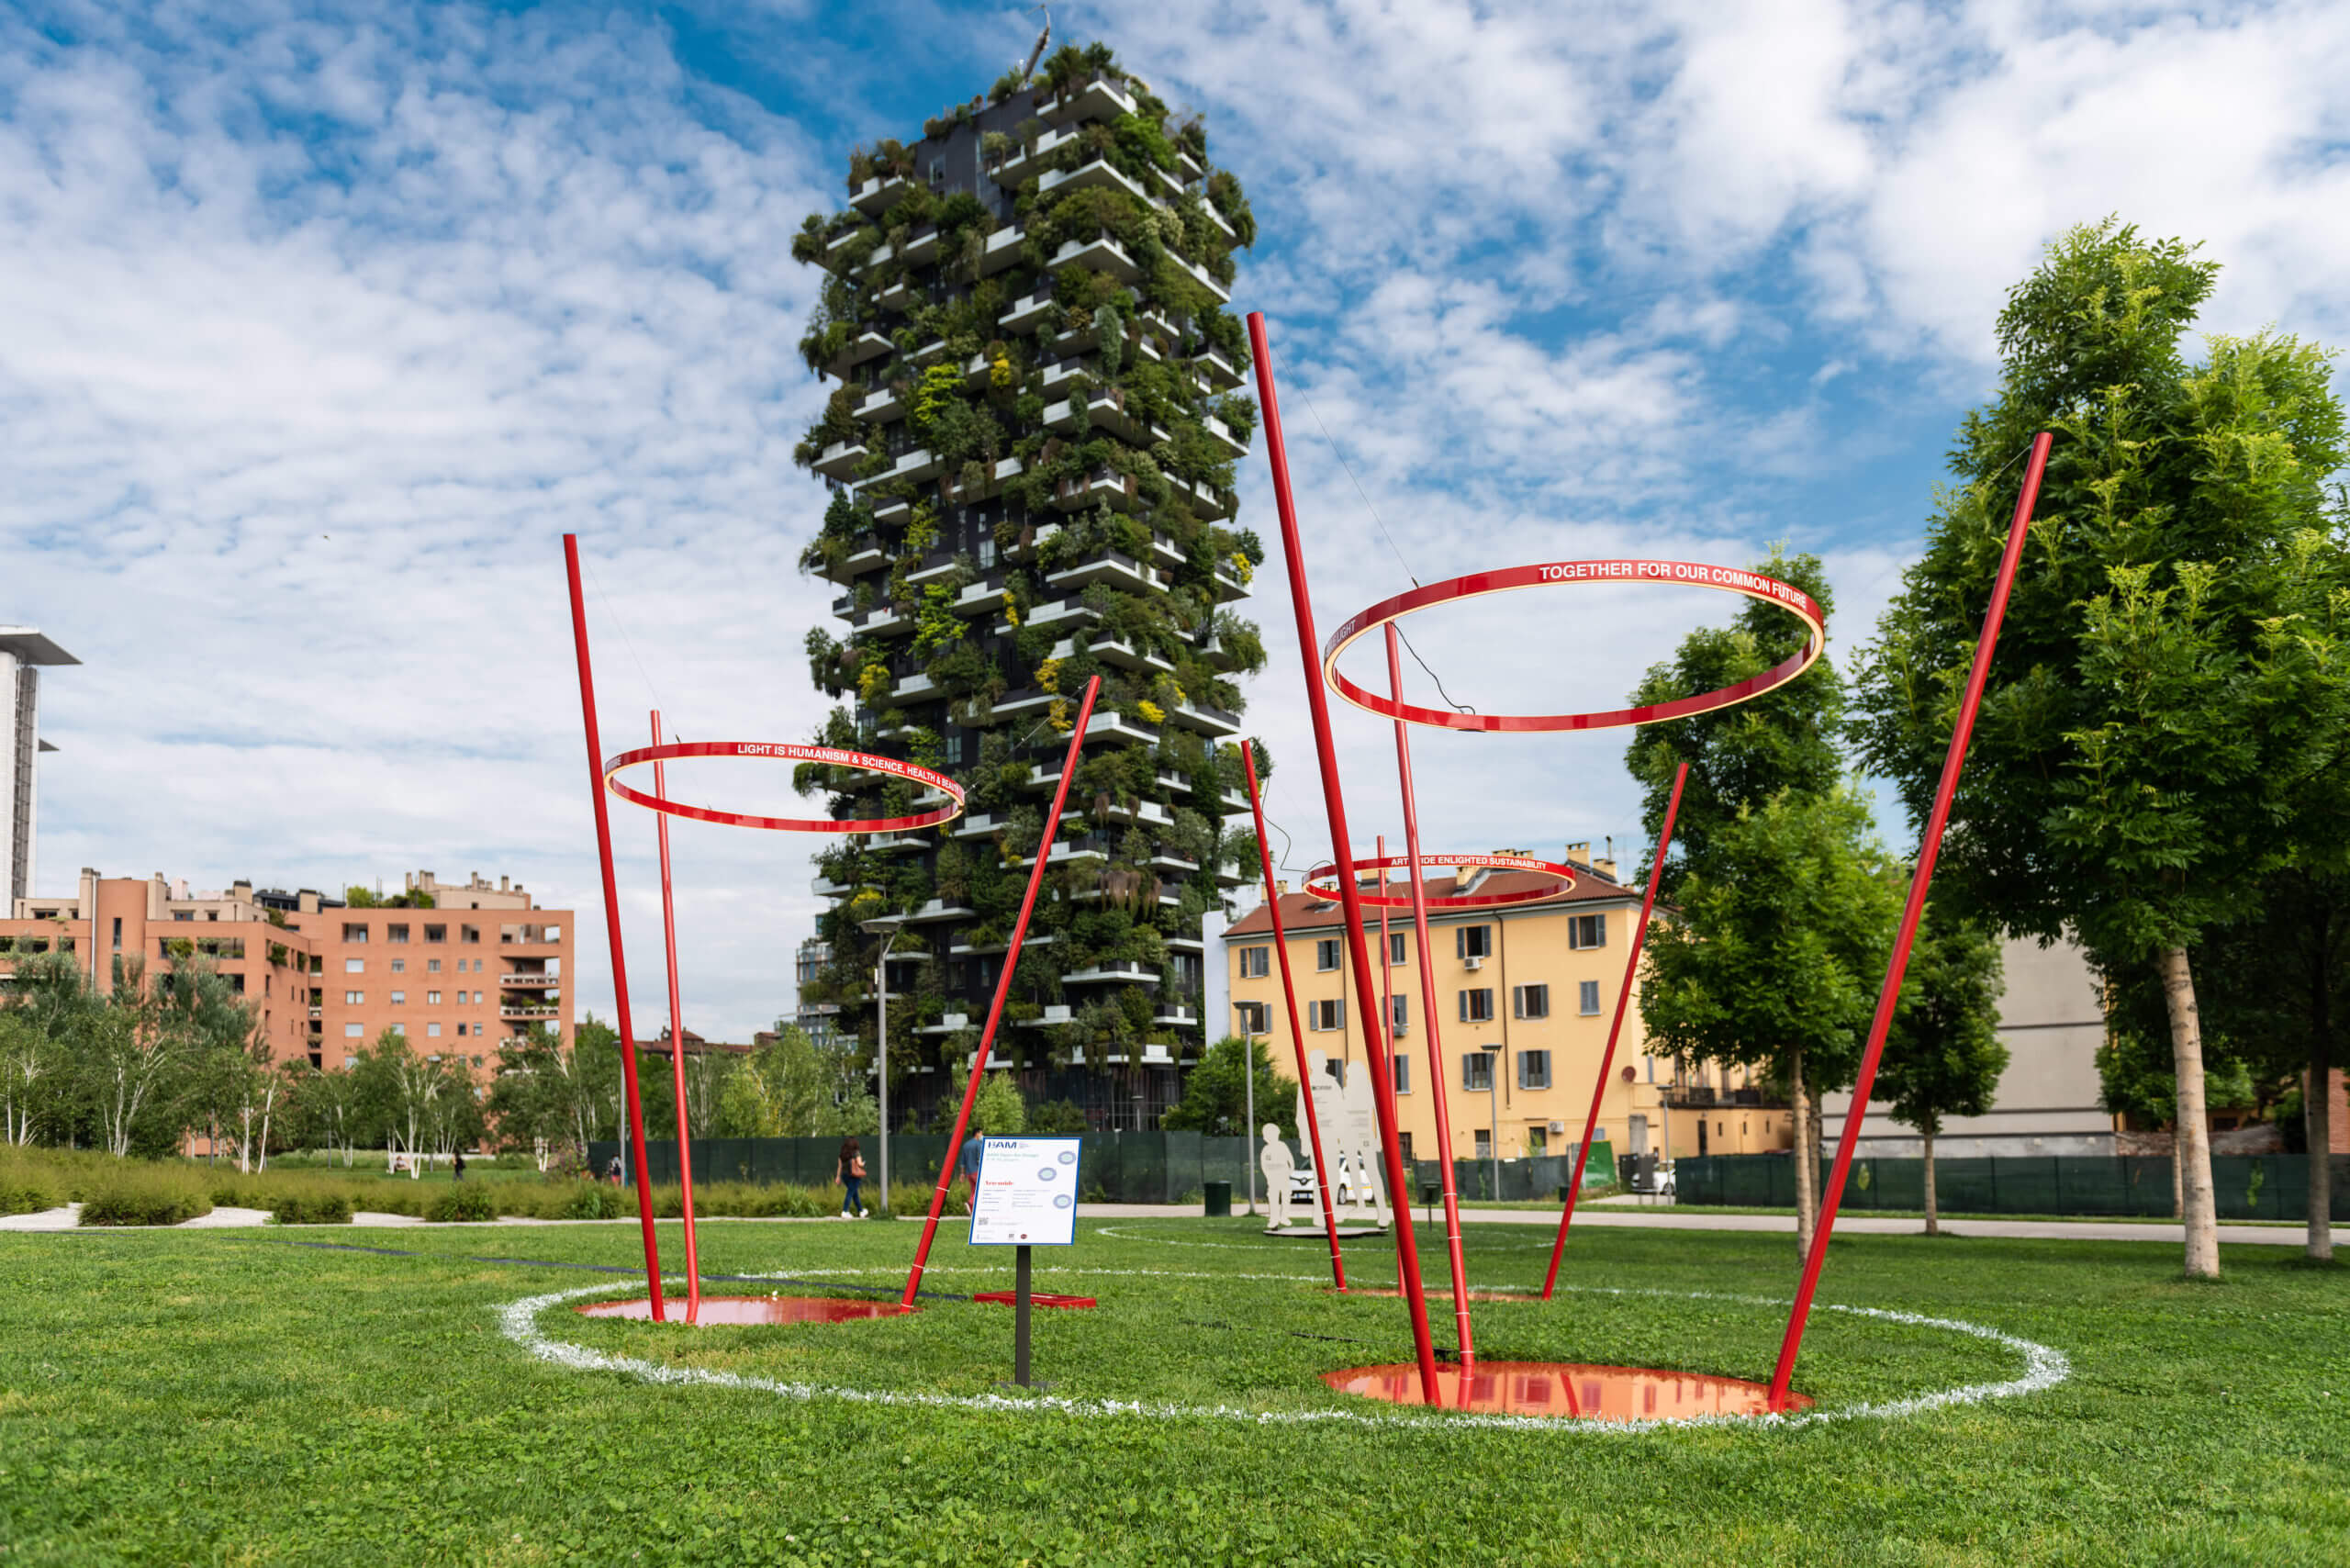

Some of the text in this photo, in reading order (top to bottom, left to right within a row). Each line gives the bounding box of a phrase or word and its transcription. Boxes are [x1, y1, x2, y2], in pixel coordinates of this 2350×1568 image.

[1539, 562, 1807, 610] TOGETHER FOR OUR COMMON FUTURE
[1337, 620, 1356, 643] LIGHT
[737, 744, 771, 755] LIGHT
[774, 745, 786, 756] IS
[788, 746, 849, 763] HUMANISM
[851, 756, 859, 765] &
[861, 756, 905, 775] SCIENCE,
[907, 766, 935, 783] HEALTH
[1391, 857, 1409, 867] ART
[1438, 856, 1488, 865] ENLIGHTED
[1489, 857, 1547, 870] SUSTAINABILITY
